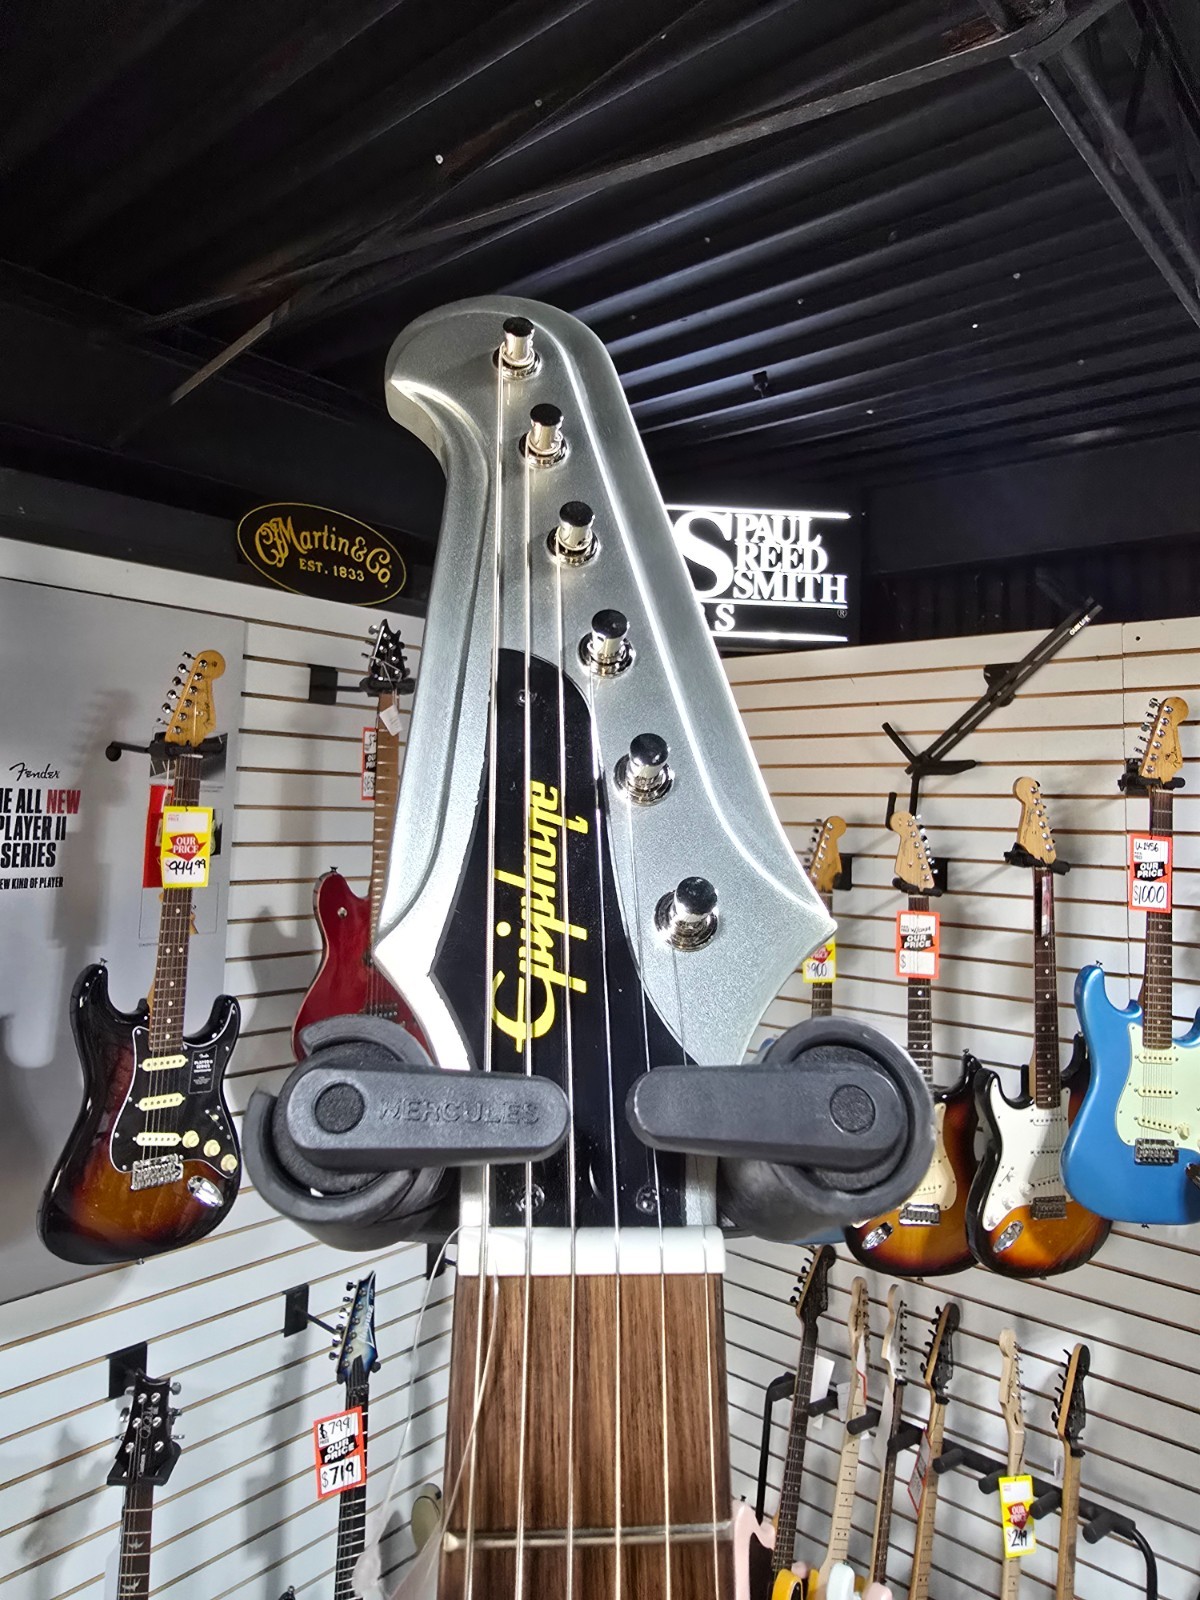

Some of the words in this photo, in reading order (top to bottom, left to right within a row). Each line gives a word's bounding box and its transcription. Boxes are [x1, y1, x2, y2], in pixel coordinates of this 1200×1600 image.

[735, 513, 823, 547] PAUL
[734, 541, 829, 574] REED
[299, 558, 328, 575] EST.
[333, 565, 365, 582] 1833
[733, 570, 848, 604] SMITH
[701, 603, 736, 632] S
[9, 762, 61, 781] Fender
[15, 788, 42, 814] ALL
[46, 789, 81, 814] NEW
[55, 816, 67, 841] II
[173, 845, 200, 854] PRICE
[176, 837, 196, 845] OUR
[0, 842, 57, 868] SERIES
[1140, 863, 1159, 871] OUR
[11, 877, 29, 889] KIND
[29, 877, 39, 889] OF
[39, 876, 64, 888] PLAYER
[1137, 869, 1164, 879] PRICE
[1134, 885, 1165, 904] $1000
[490, 779, 590, 1053] Epiphone
[904, 940, 932, 949] PRICE
[377, 1097, 541, 1125] HERCULES
[324, 1442, 355, 1463] PRICE
[327, 1437, 350, 1454] OUR
[322, 1461, 354, 1488] $719
